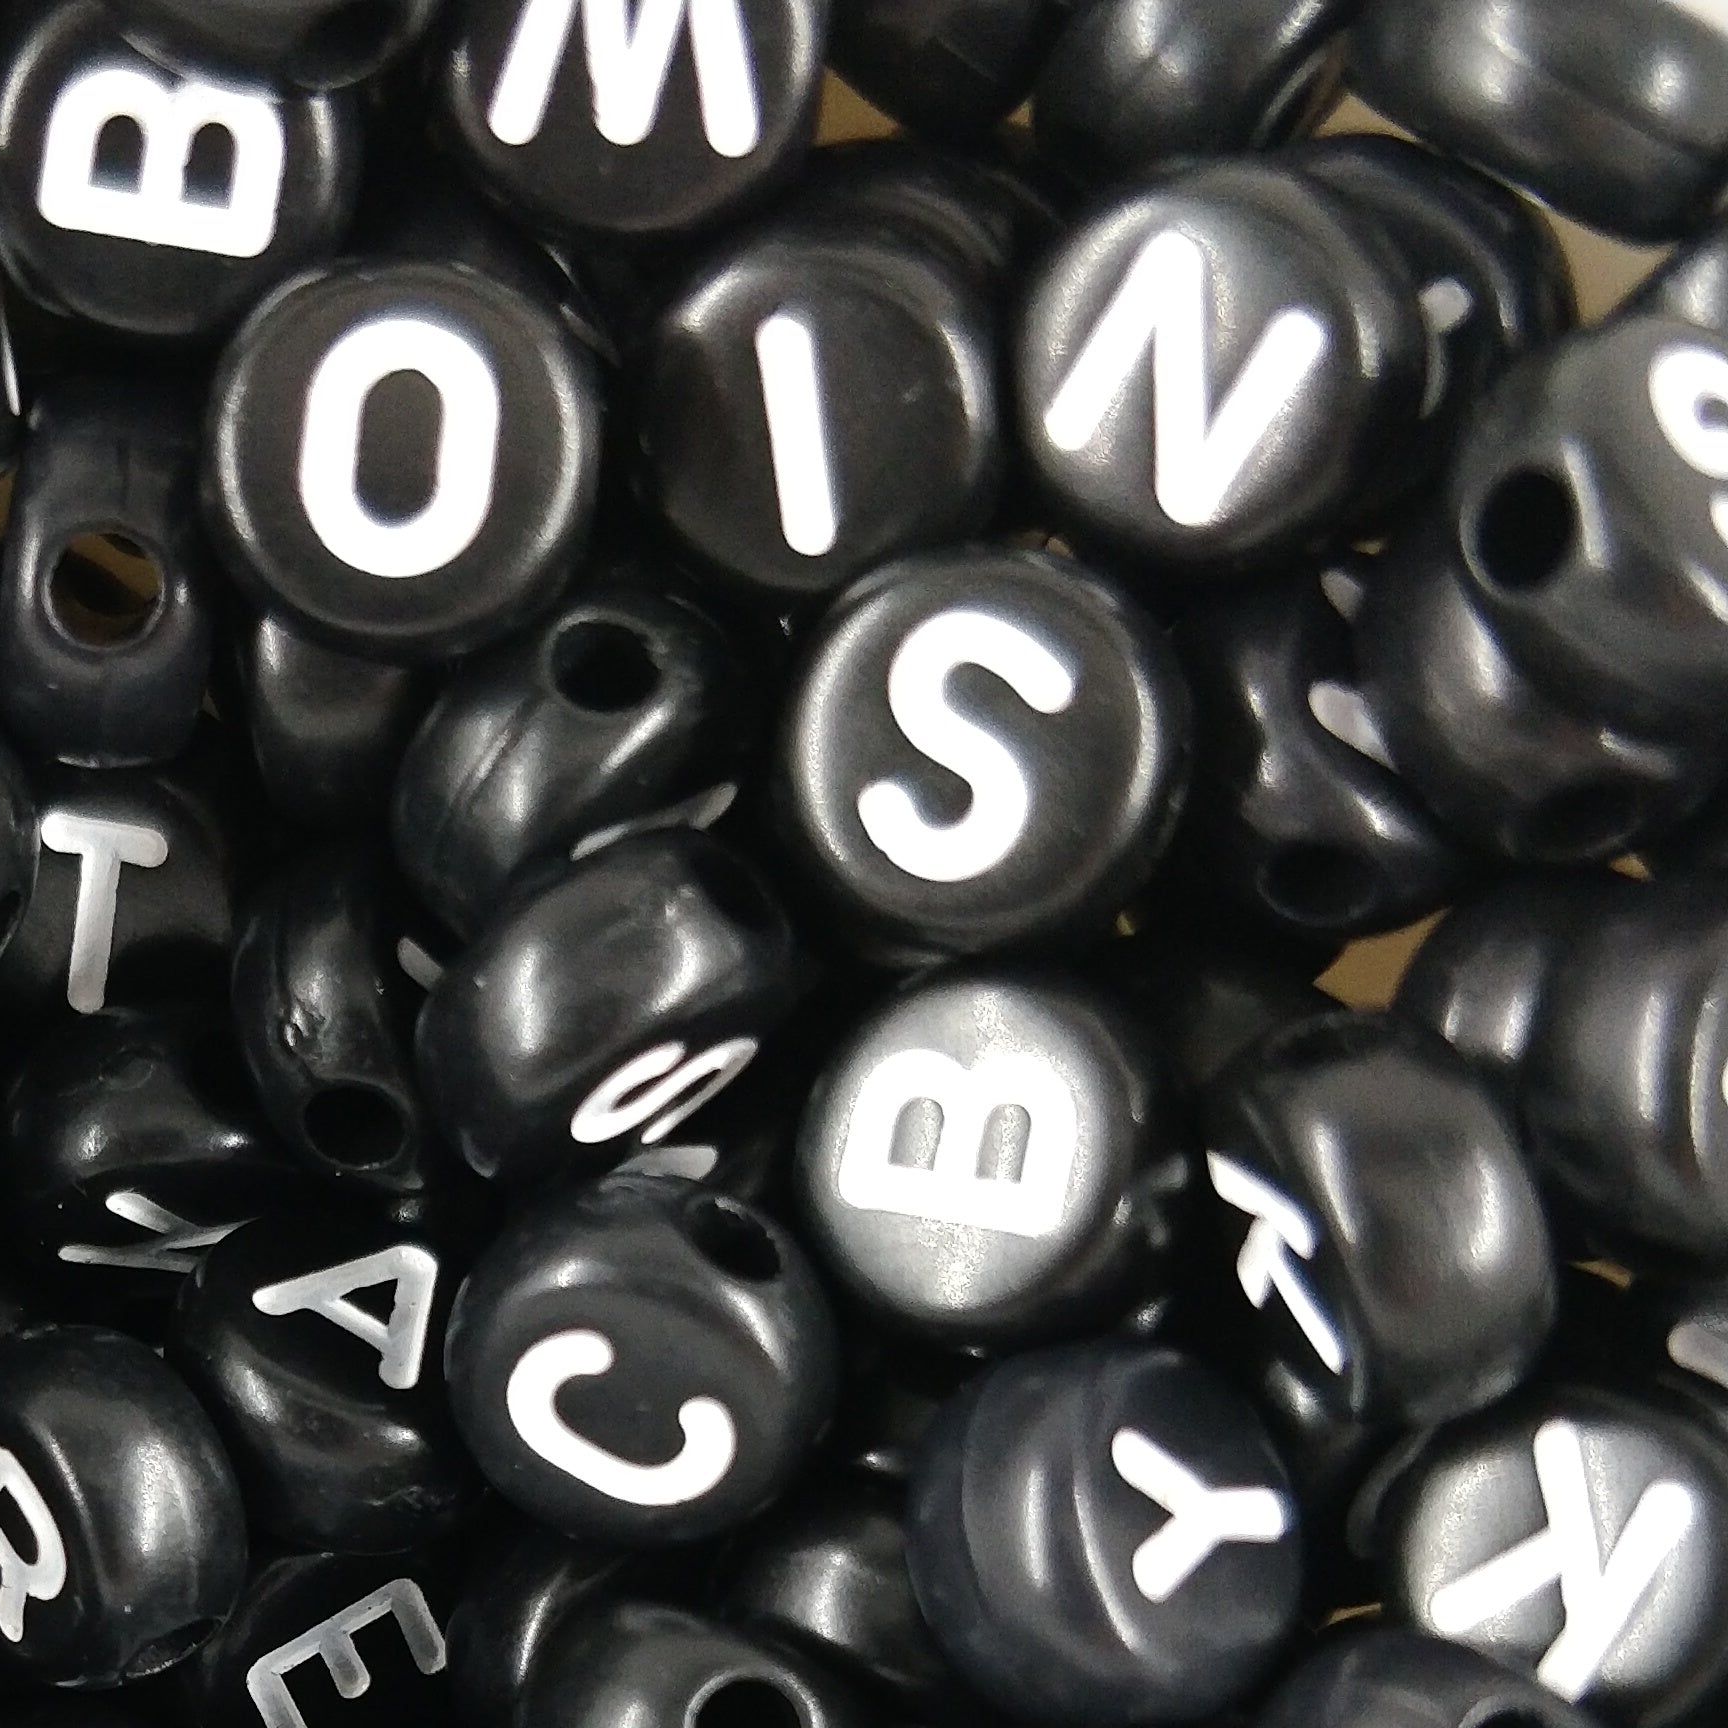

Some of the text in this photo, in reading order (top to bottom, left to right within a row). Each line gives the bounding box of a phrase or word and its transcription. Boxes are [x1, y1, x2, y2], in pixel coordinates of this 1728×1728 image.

[40, 66, 283, 256] B
[300, 316, 497, 577] O
[756, 310, 838, 555] I
[1045, 230, 1324, 525] N
[860, 610, 1075, 882] S
[40, 812, 168, 1011] T
[572, 1040, 757, 1144] S
[838, 1049, 1079, 1237] B
[252, 1246, 438, 1389] A
[508, 1331, 735, 1506] C
[1113, 1429, 1285, 1600] Y
